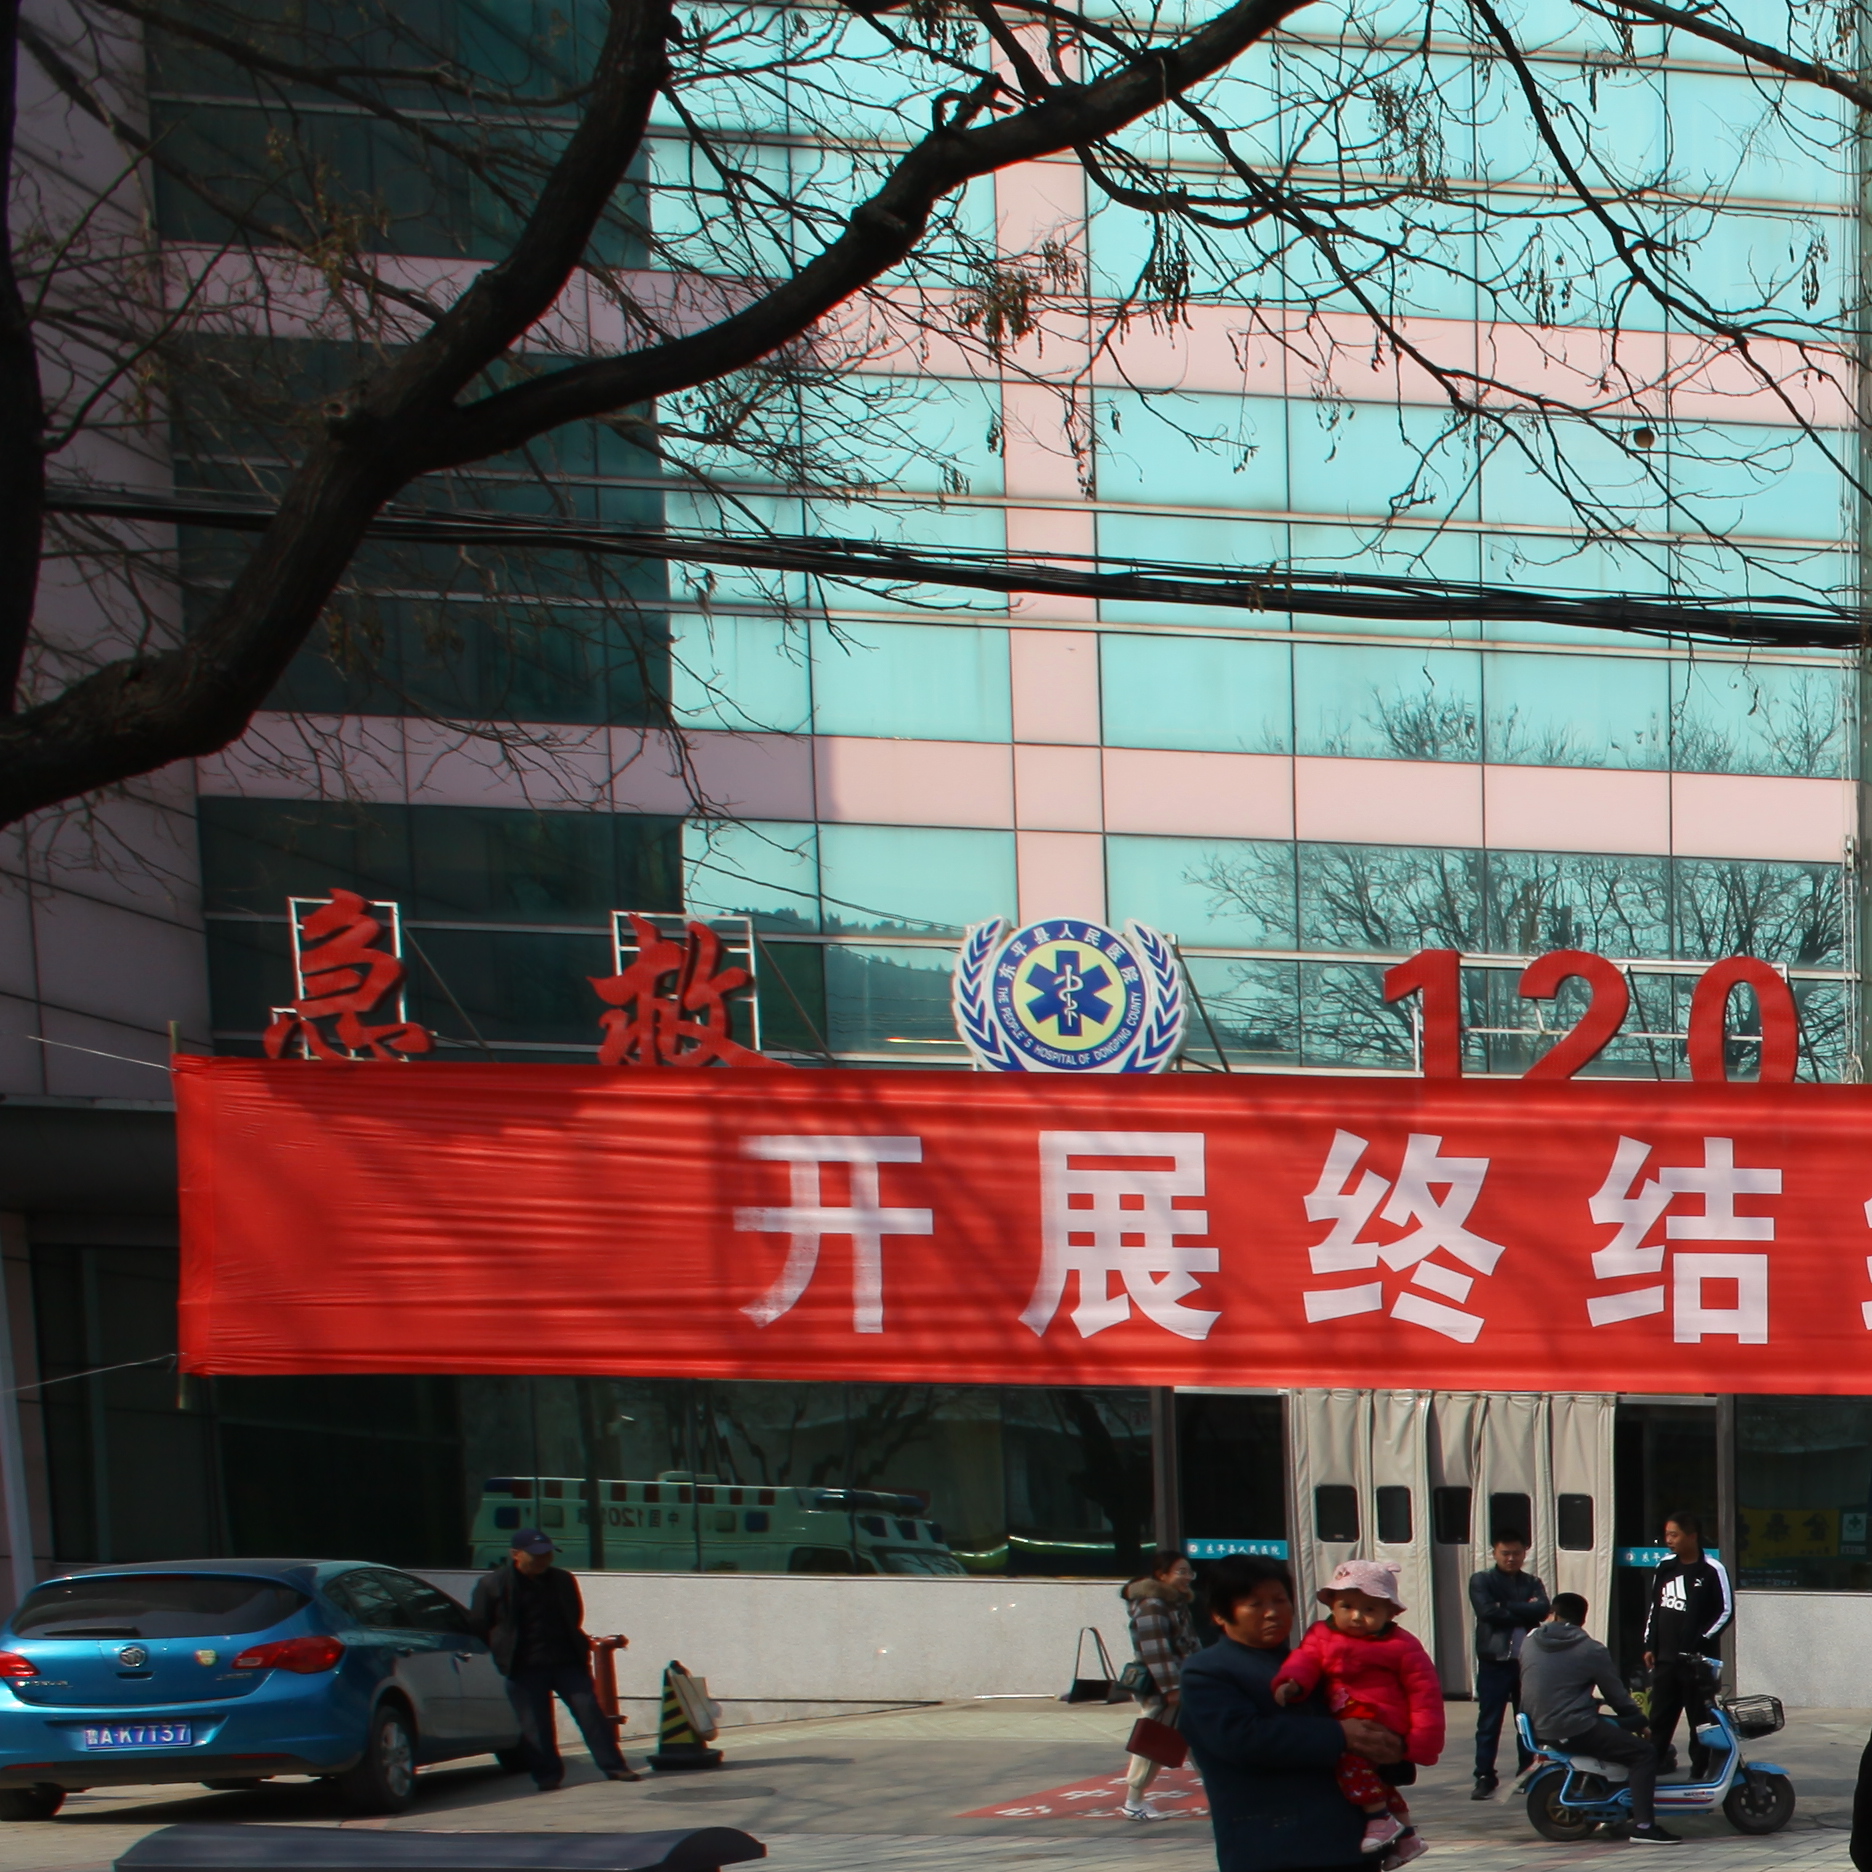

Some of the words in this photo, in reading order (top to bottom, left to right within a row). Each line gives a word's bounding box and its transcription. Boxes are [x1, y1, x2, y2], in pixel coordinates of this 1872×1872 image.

[264, 888, 797, 1067] 急救
[1383, 949, 1799, 1082] 120
[998, 922, 1139, 985] 东平县人民医院
[997, 986, 1009, 1004] THE
[1033, 1044, 1077, 1065] HOSPITAL
[1078, 1052, 1091, 1065] OF
[1094, 1027, 1132, 1060] DONGPING
[1126, 991, 1142, 1026] COUNTY
